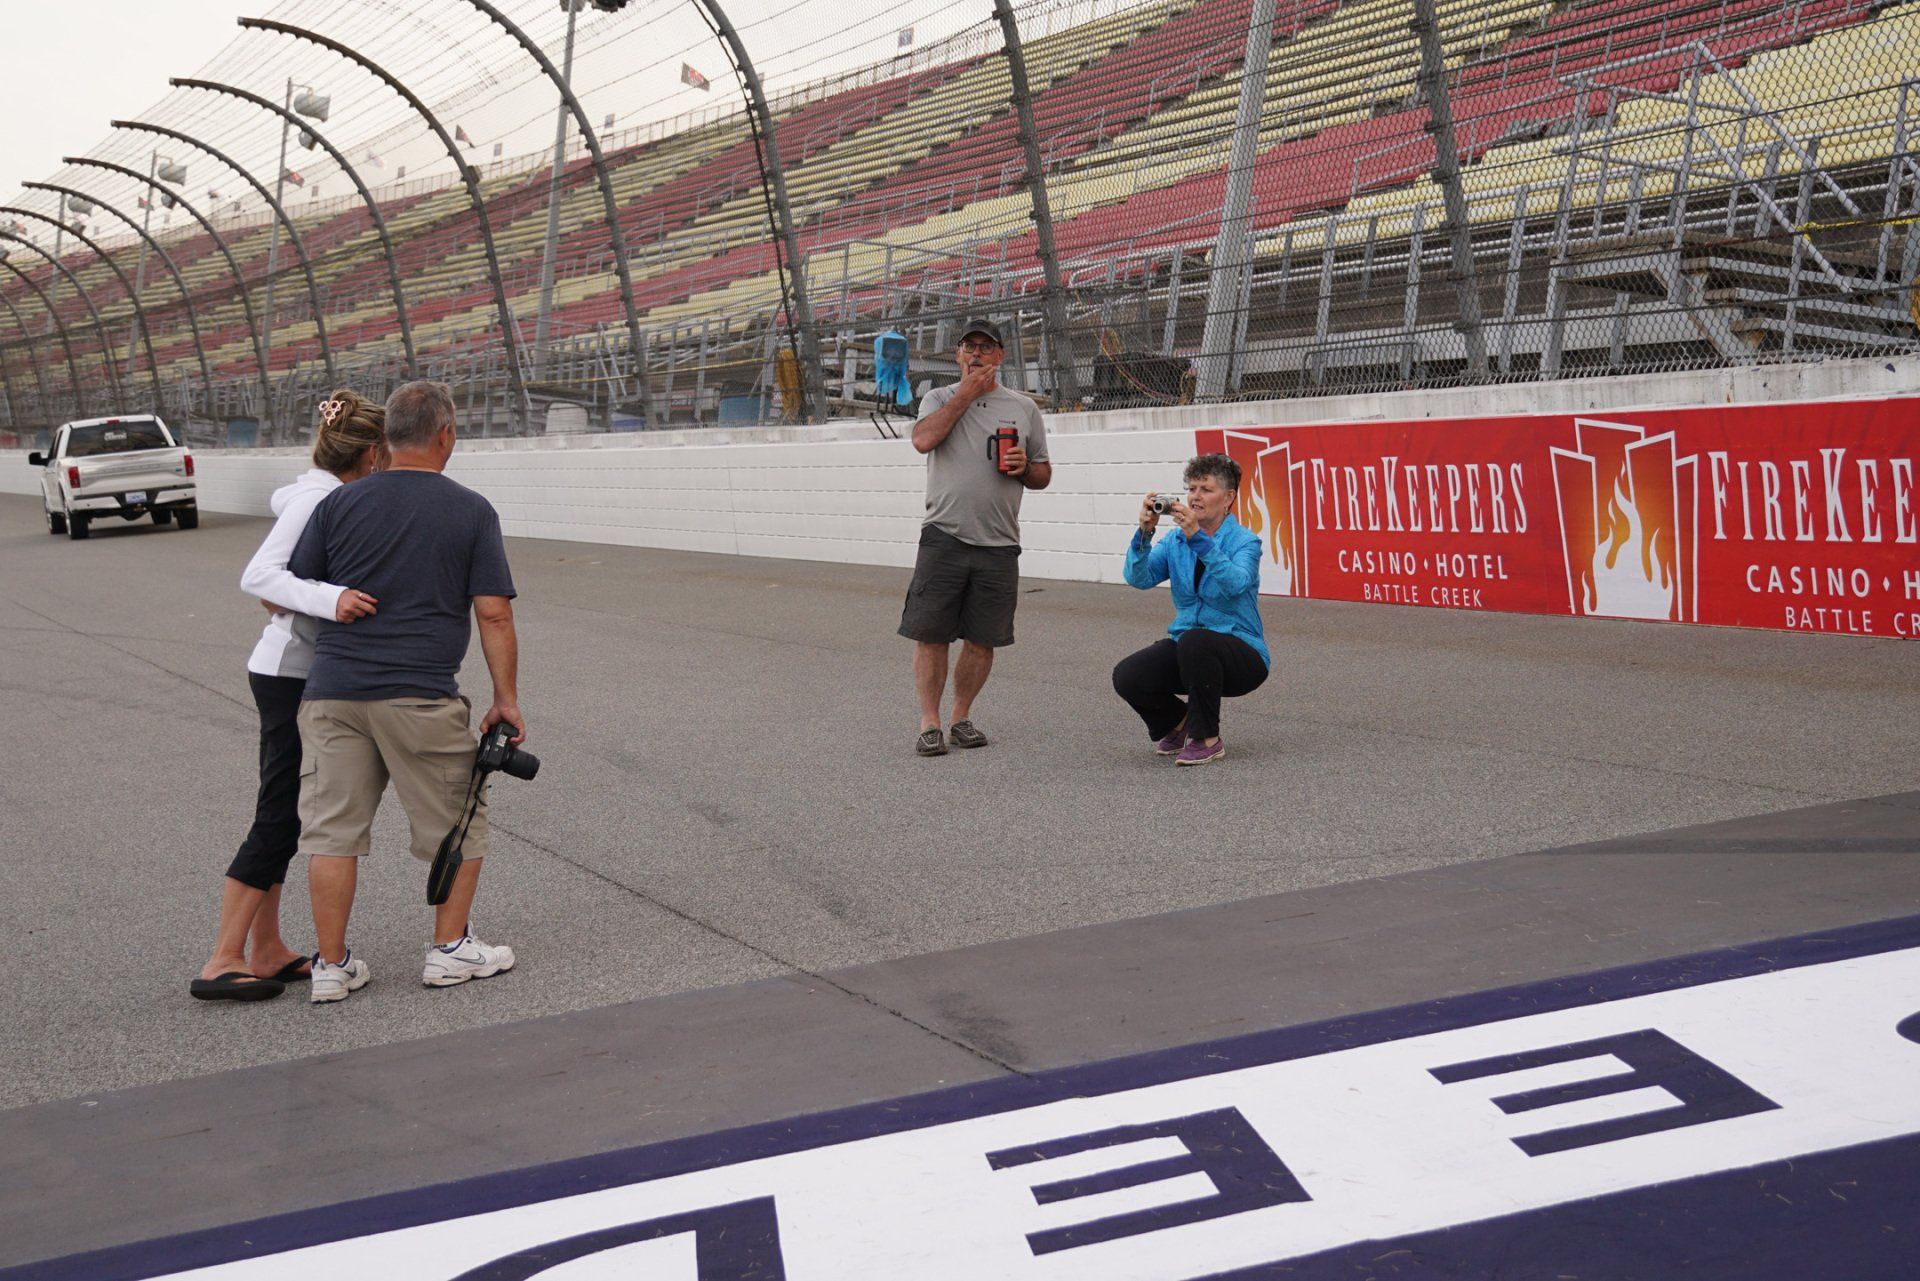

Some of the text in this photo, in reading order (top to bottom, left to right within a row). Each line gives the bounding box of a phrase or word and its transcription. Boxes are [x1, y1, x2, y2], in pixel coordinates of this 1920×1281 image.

[1310, 456, 1527, 534] FIREKEEPERS
[1338, 549, 1508, 580] CASINO HOTEL
[1363, 583, 1482, 608] BATTLE CREEK
[1746, 564, 1870, 598] CASINO
[1785, 606, 1873, 633] BATTLE
